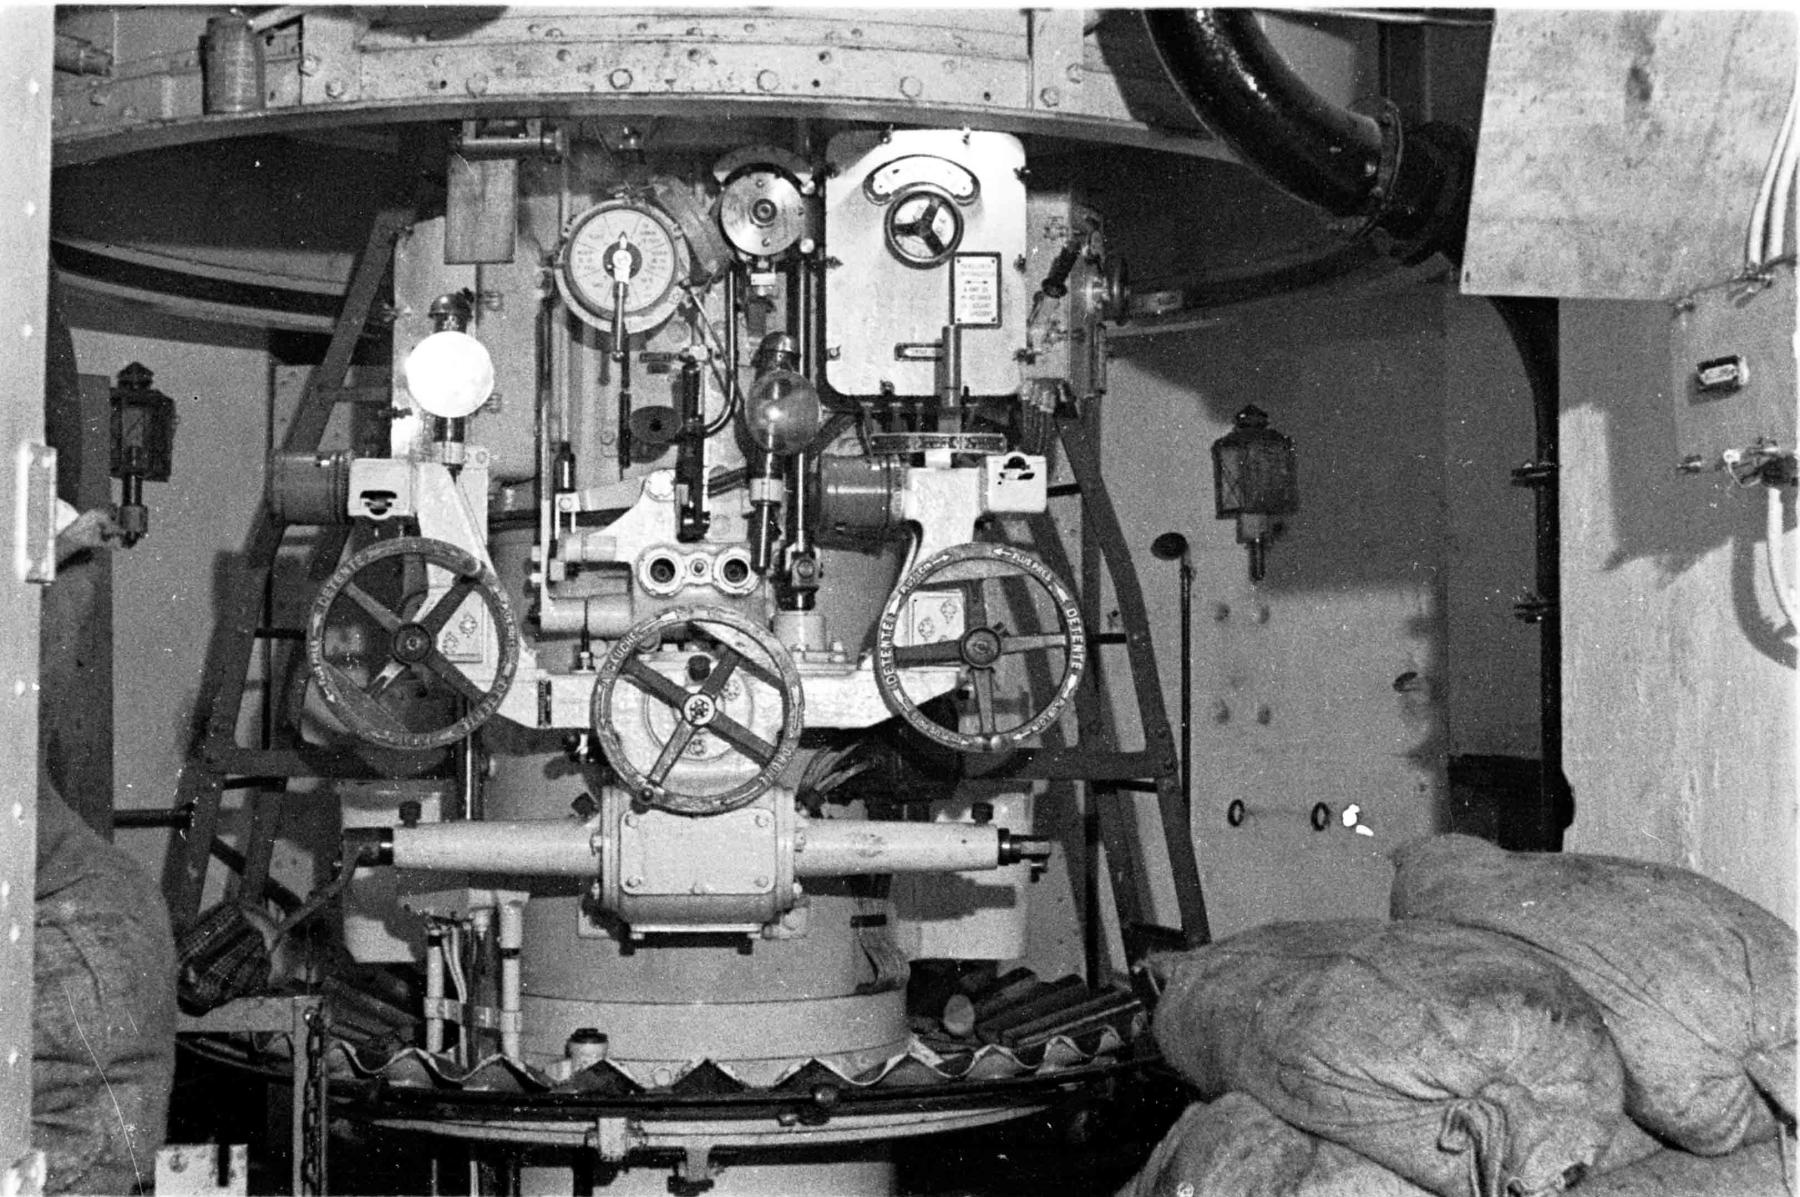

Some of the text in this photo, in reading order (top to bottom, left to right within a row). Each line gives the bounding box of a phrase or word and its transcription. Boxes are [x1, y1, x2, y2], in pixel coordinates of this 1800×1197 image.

[317, 554, 365, 606] DETENTE
[605, 632, 638, 671] GAUCHE
[880, 622, 897, 685] DETENTE
[1065, 606, 1084, 669] DETENTE
[758, 746, 791, 786] DROITE
